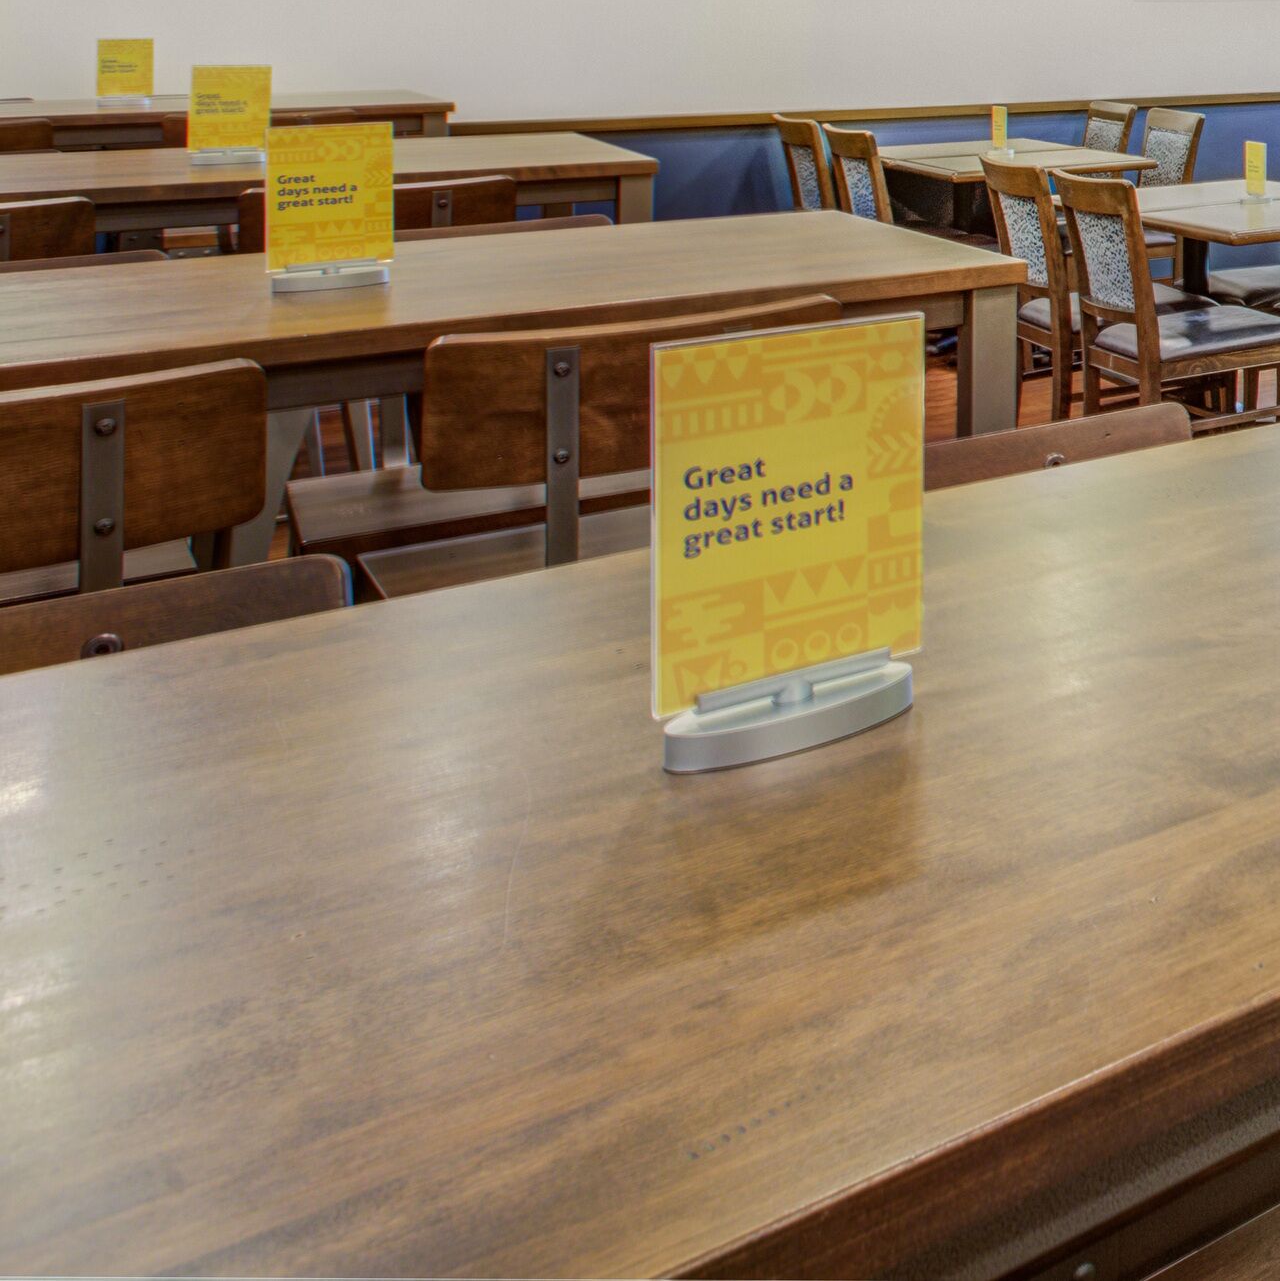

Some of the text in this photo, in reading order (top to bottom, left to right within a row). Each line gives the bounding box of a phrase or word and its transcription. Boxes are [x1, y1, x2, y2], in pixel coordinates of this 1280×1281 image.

[277, 175, 315, 185] Great
[277, 183, 358, 198] days need a
[277, 194, 353, 211] great start!
[683, 457, 766, 491] Great
[683, 472, 854, 522] days need a
[683, 500, 846, 558] great start!
